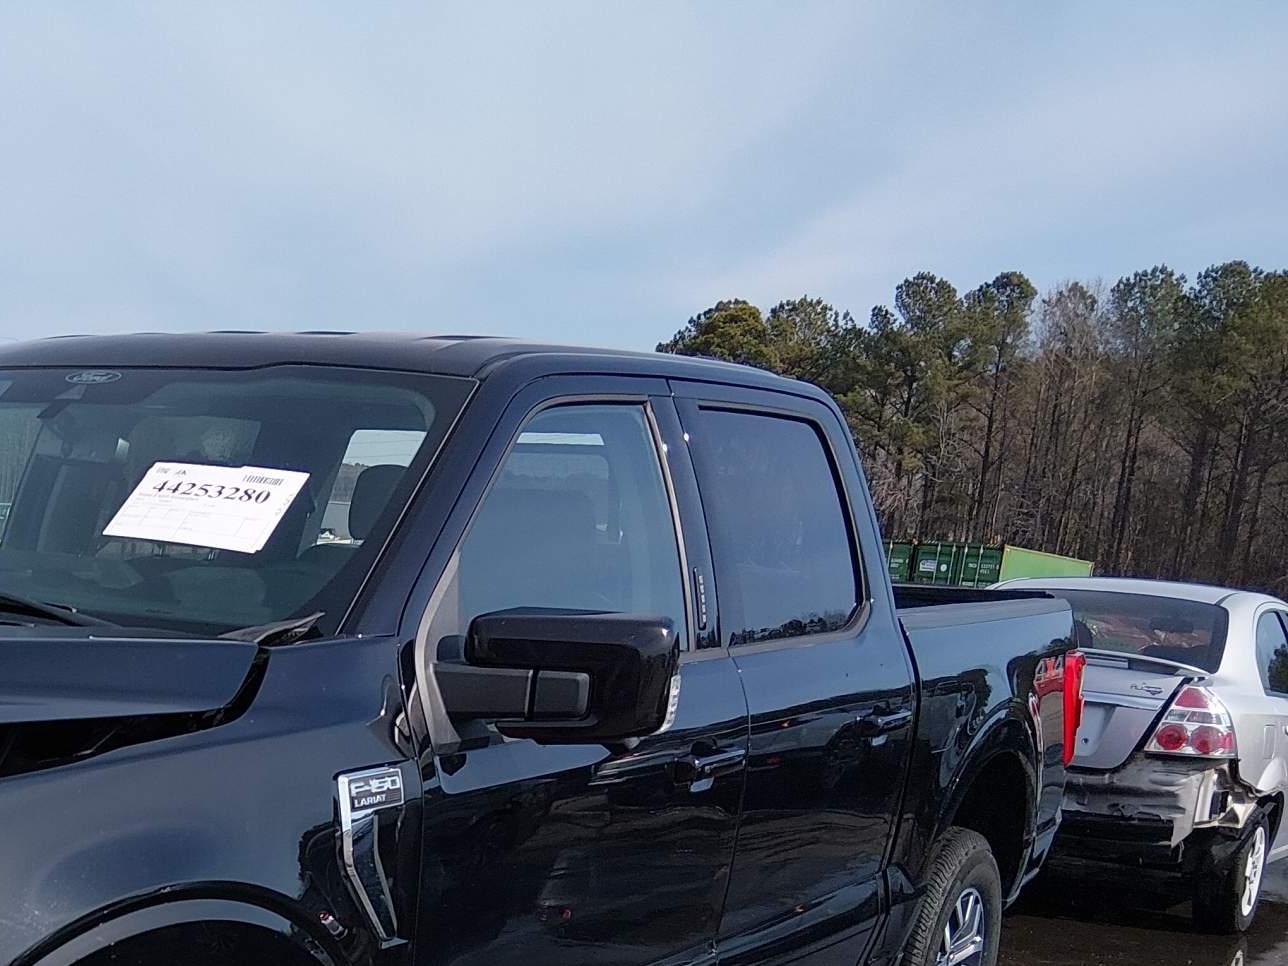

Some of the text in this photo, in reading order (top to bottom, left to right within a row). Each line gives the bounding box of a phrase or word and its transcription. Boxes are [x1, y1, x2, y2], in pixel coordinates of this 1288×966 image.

[153, 479, 271, 505] 44253280
[350, 775, 401, 797] F-150
[354, 793, 387, 808] LARIAT
